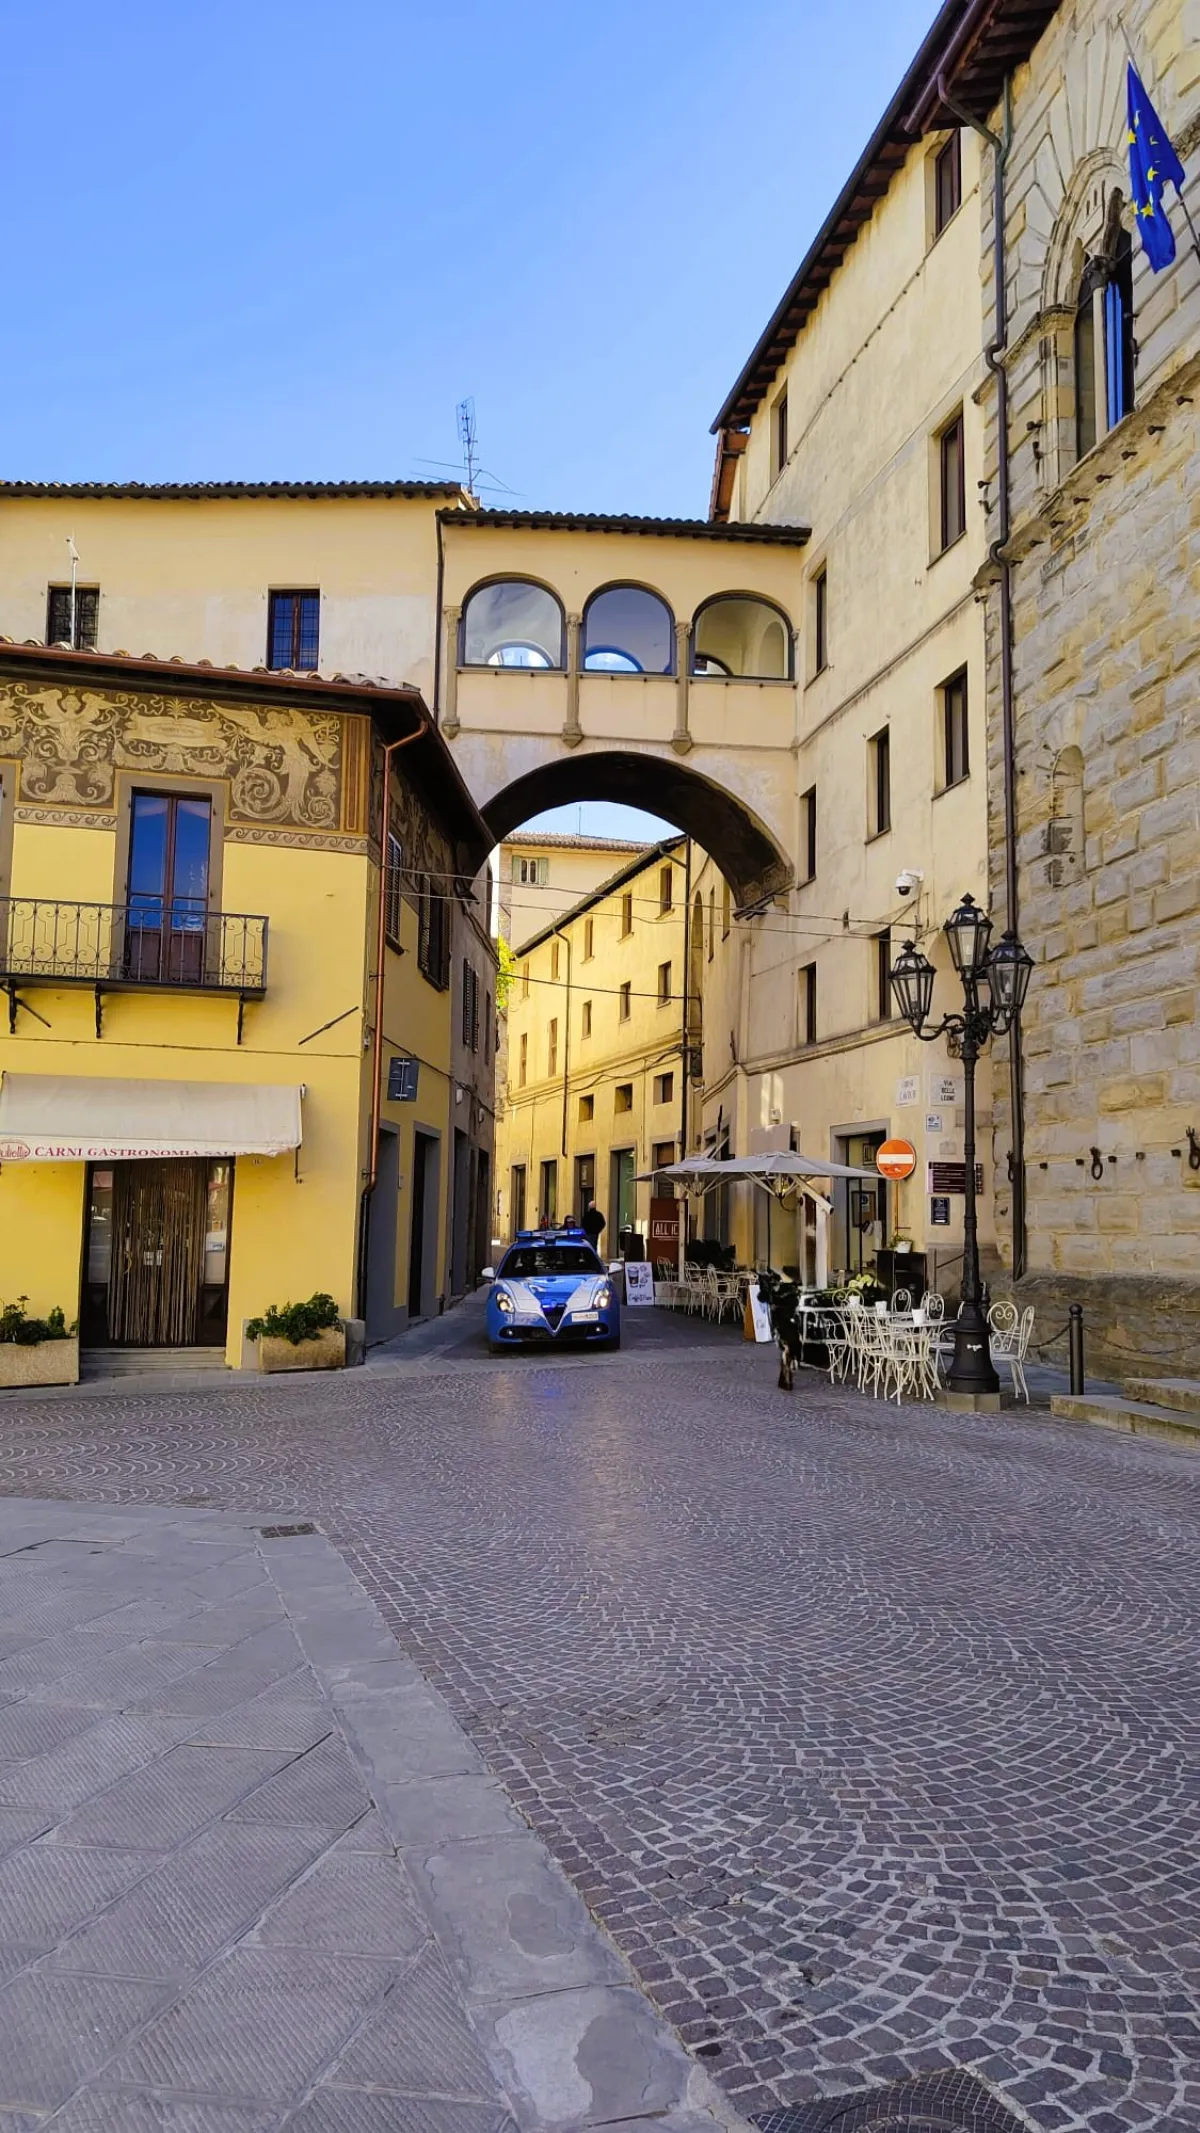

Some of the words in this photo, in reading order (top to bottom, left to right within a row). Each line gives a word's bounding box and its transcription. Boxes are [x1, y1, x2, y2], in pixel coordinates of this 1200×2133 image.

[943, 1079, 953, 1087] VIA
[34, 1146, 83, 1157] CARNI
[87, 1147, 200, 1157] GASTRONOMIA
[655, 1222, 670, 1236] ALL
